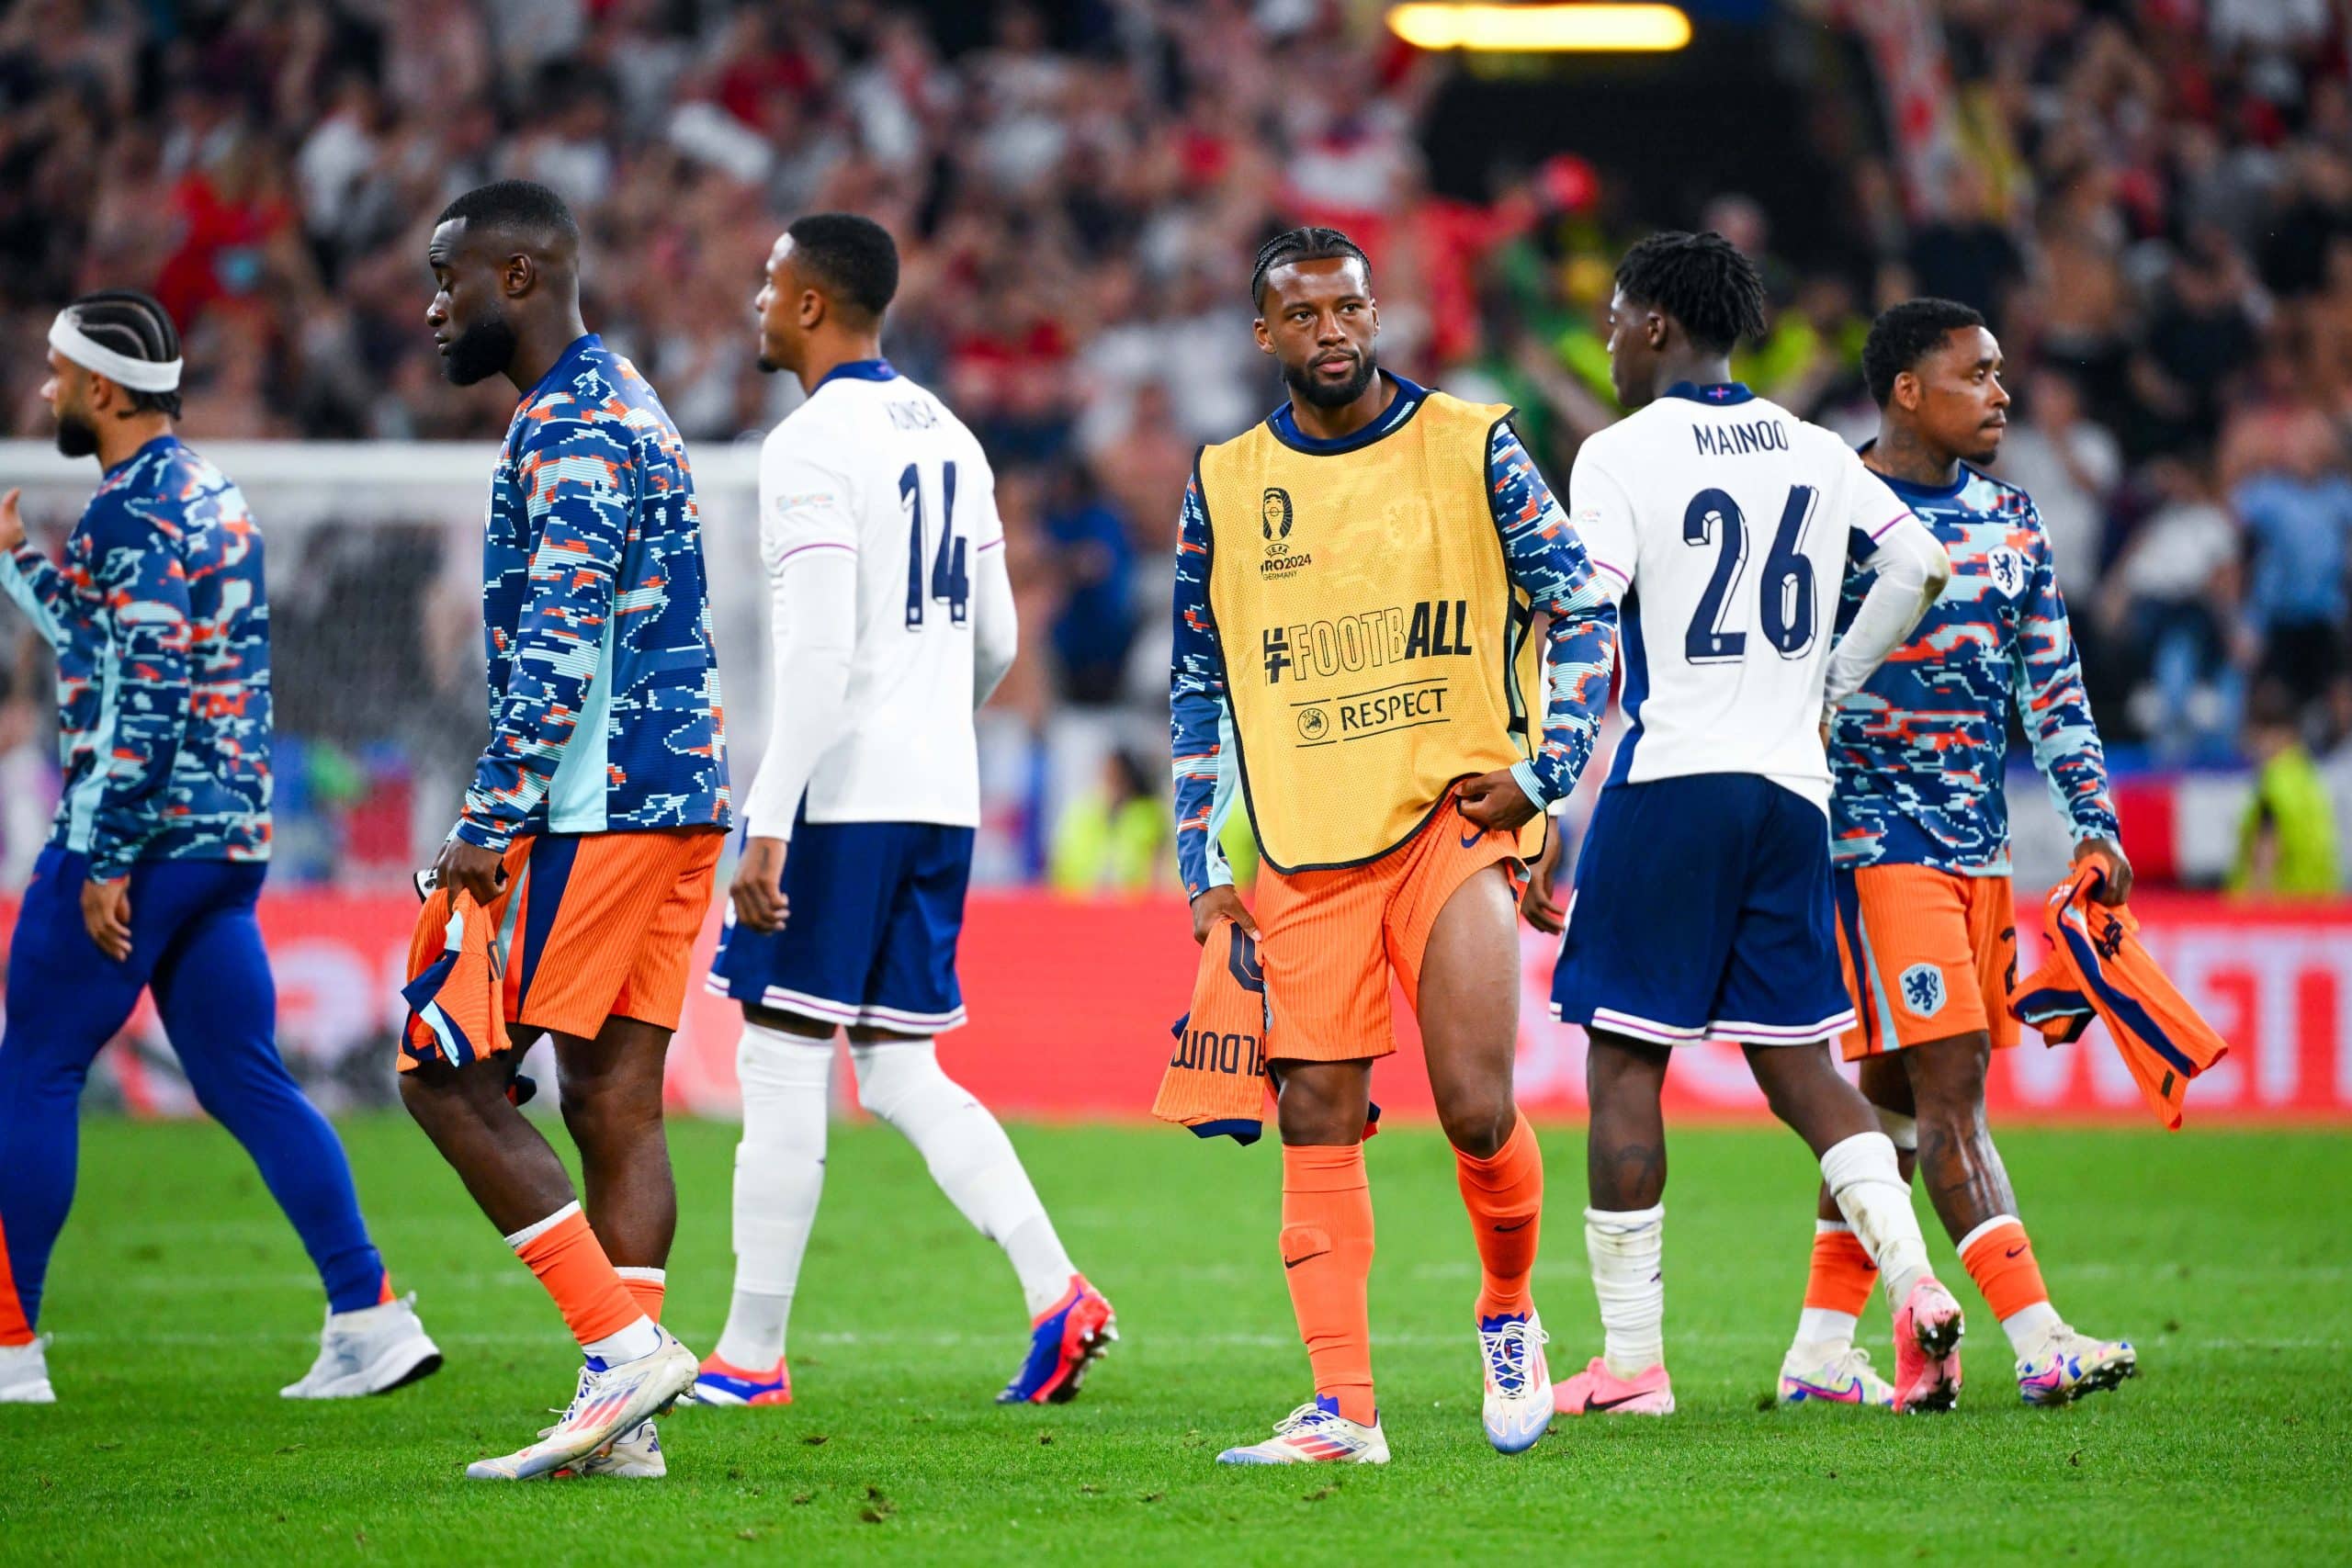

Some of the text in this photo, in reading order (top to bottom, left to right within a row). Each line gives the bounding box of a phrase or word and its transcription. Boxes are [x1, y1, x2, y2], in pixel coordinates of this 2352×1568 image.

[1692, 420, 1790, 456] MAINOO
[899, 461, 969, 632] 14
[1260, 553, 1312, 576] RO2024
[1683, 485, 1819, 665] 26
[1263, 600, 1472, 686] #FOOTBALL
[1340, 688, 1448, 731] RESPECT
